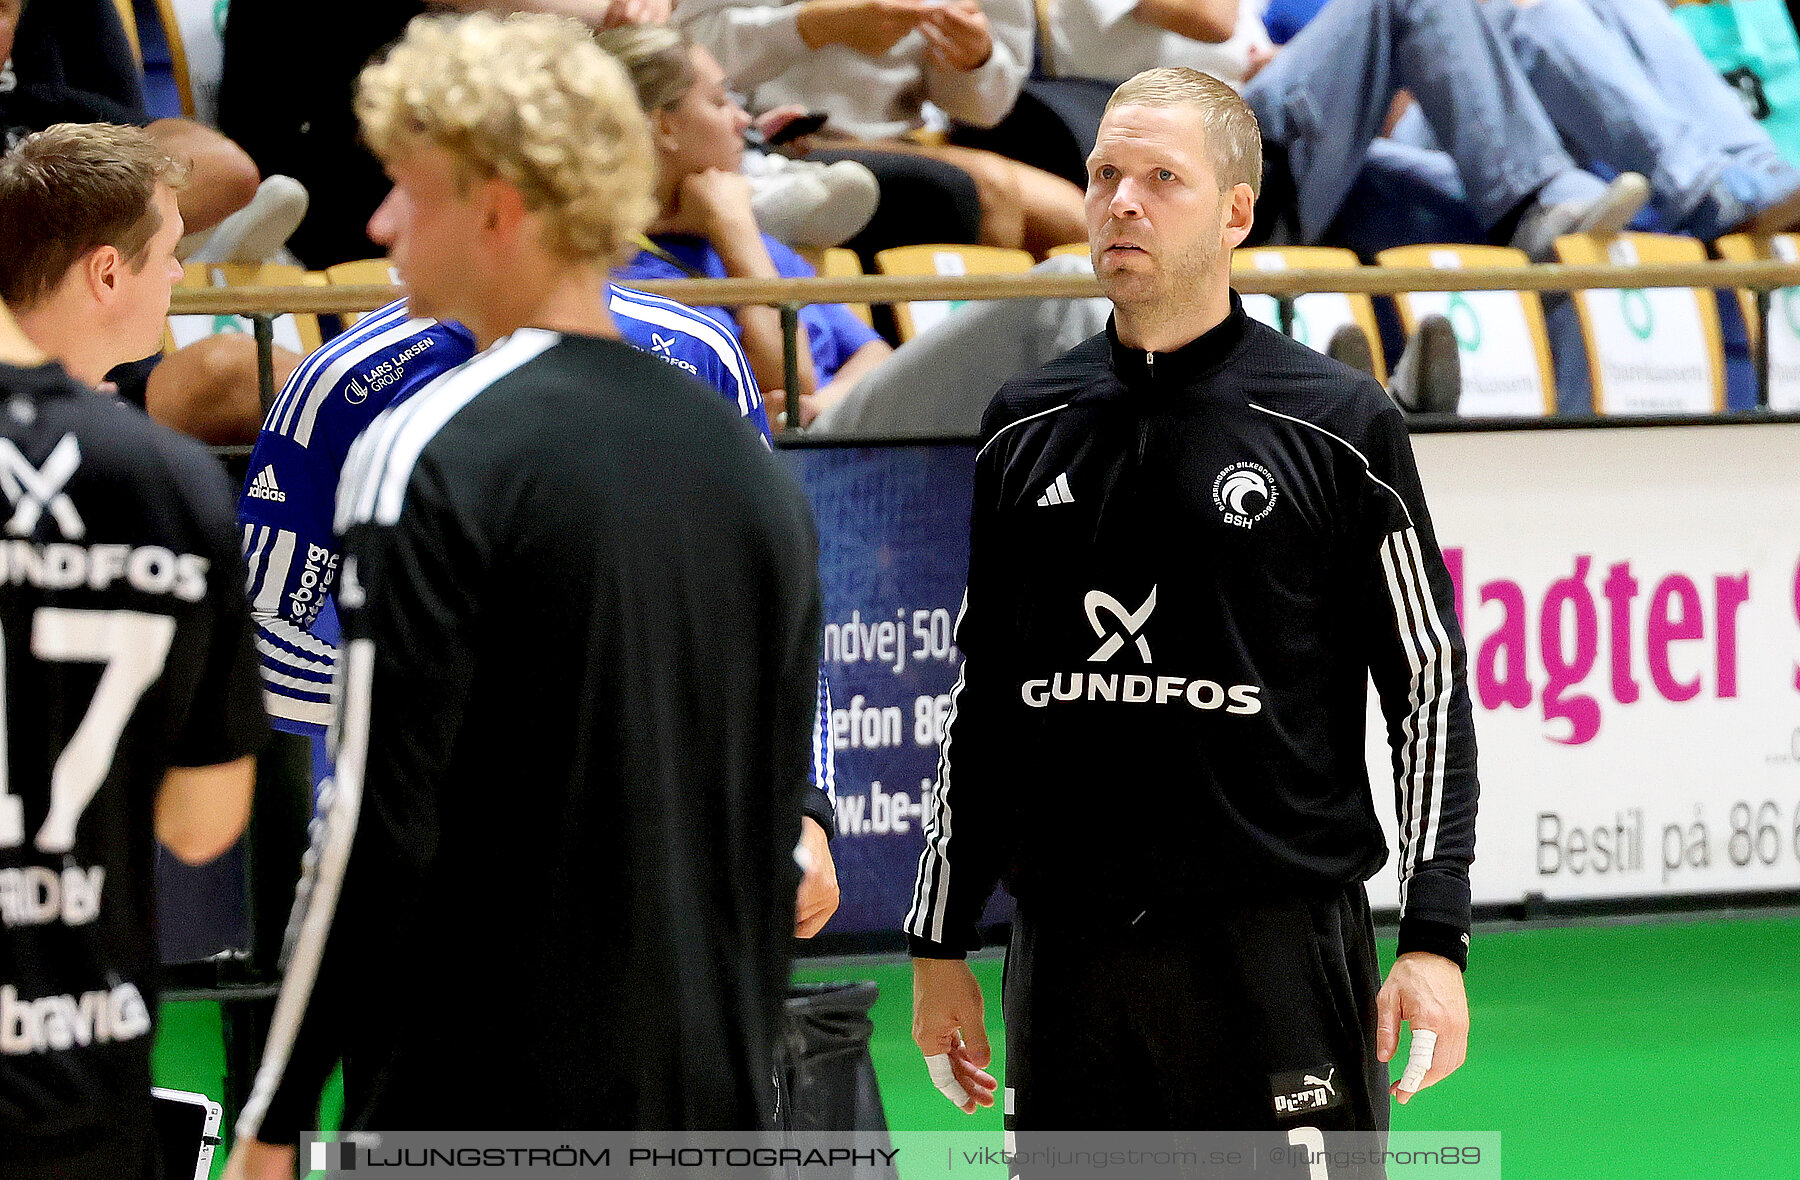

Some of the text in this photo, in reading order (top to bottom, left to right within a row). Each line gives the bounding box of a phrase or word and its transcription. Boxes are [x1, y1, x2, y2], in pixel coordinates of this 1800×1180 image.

[363, 337, 435, 383] LARS LARSEN
[371, 366, 405, 392] GROUP
[1223, 512, 1253, 530] BSH
[1021, 672, 1263, 715] GUNDFOS
[1537, 810, 1645, 876] Bestil
